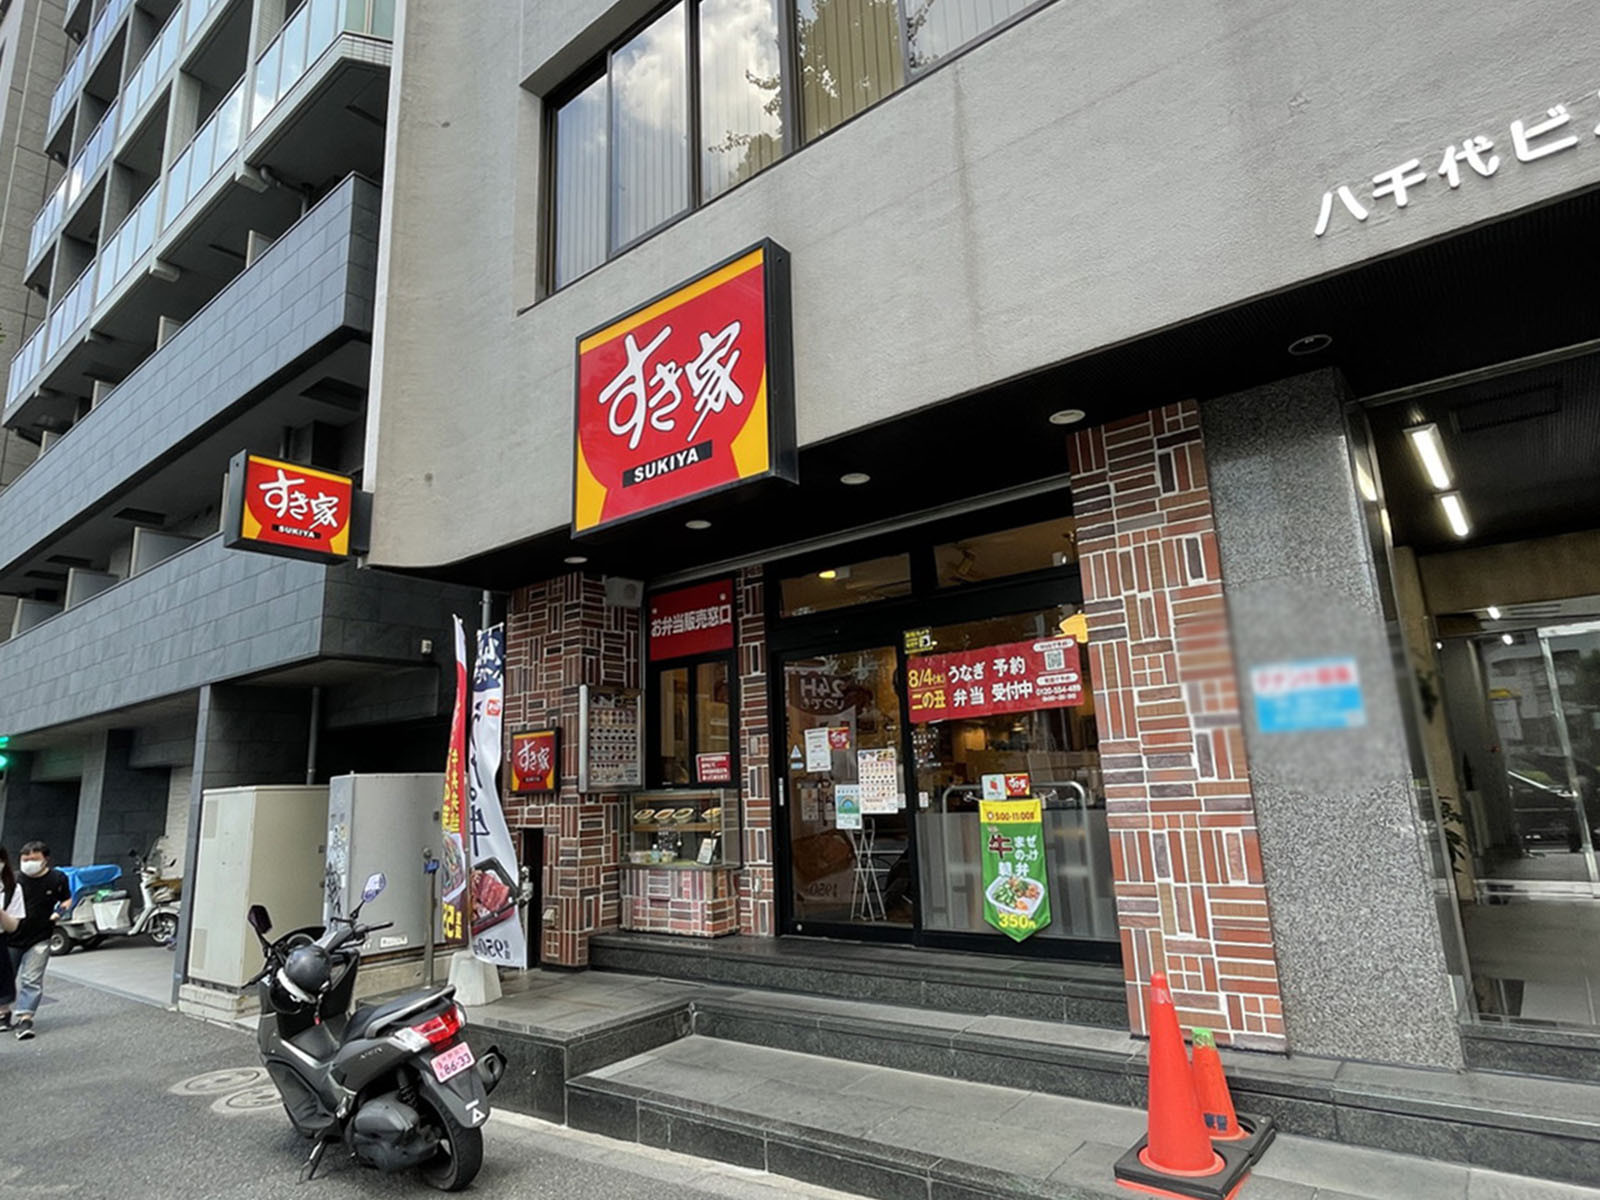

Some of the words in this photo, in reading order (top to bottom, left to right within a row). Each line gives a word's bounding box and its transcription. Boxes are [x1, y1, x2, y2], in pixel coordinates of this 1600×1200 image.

[1313, 92, 1600, 237] 八千代ビ
[598, 320, 744, 449] すき家
[633, 447, 699, 483] SUKIYA
[258, 469, 339, 529] すき家
[277, 525, 316, 539] SUKIYA
[651, 604, 732, 638] お弁当販売窓口
[948, 661, 985, 684] うなぎ
[992, 656, 1026, 677] 予約
[911, 690, 946, 710] 二の丑
[952, 686, 985, 707] 弁当
[991, 680, 1033, 702] 受付中
[517, 739, 550, 775] すき家
[989, 834, 1013, 859] 牛
